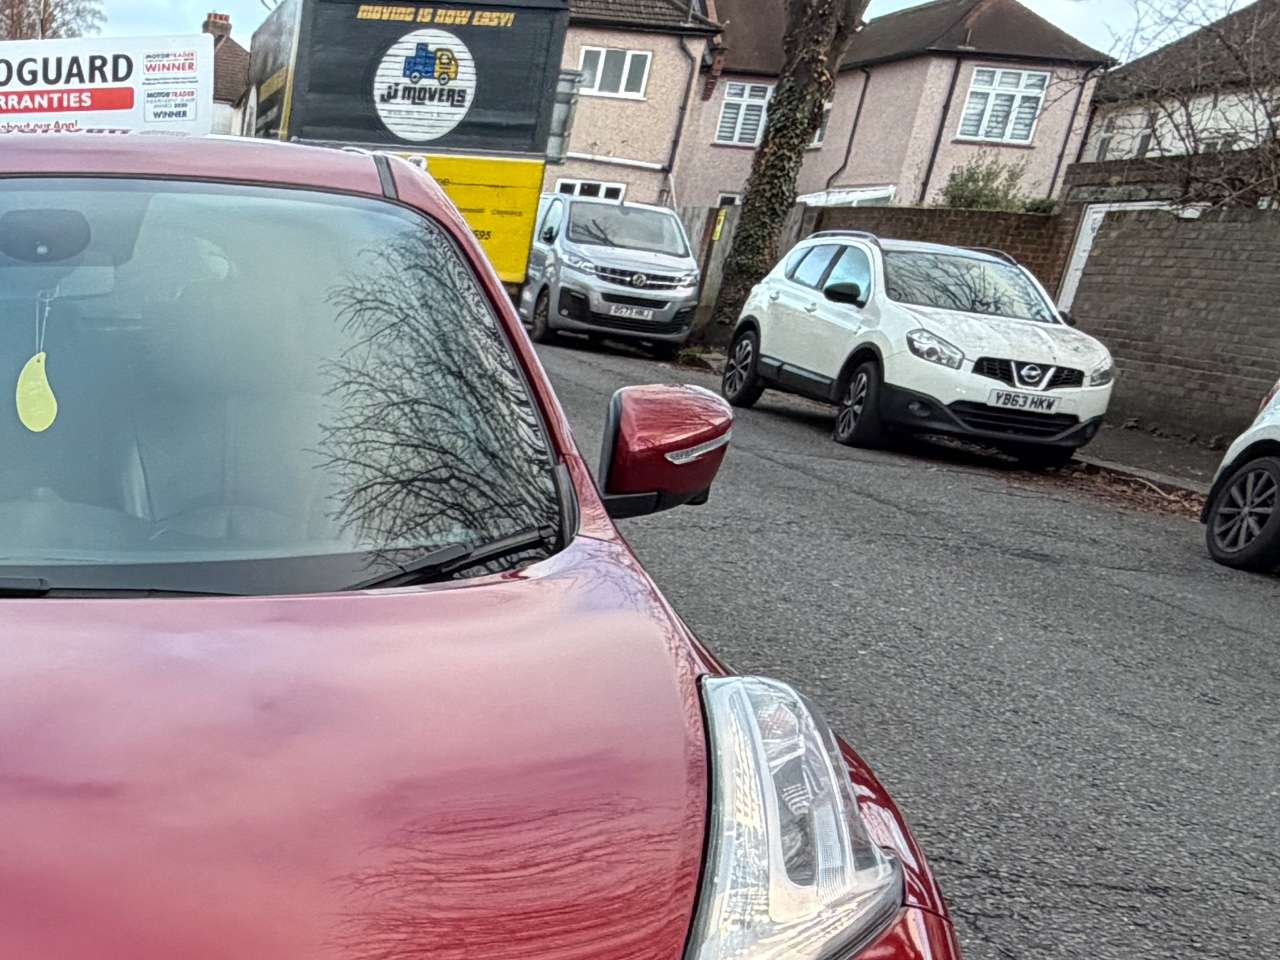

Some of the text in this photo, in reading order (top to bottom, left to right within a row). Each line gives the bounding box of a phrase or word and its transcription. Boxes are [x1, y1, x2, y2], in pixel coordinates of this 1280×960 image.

[357, 5, 515, 27] MOVING IS NOW EASY!
[145, 62, 194, 72] WINNER
[402, 86, 467, 108] MOVERS
[153, 110, 187, 118] WINNER
[996, 392, 1056, 411] YB63 HKW
